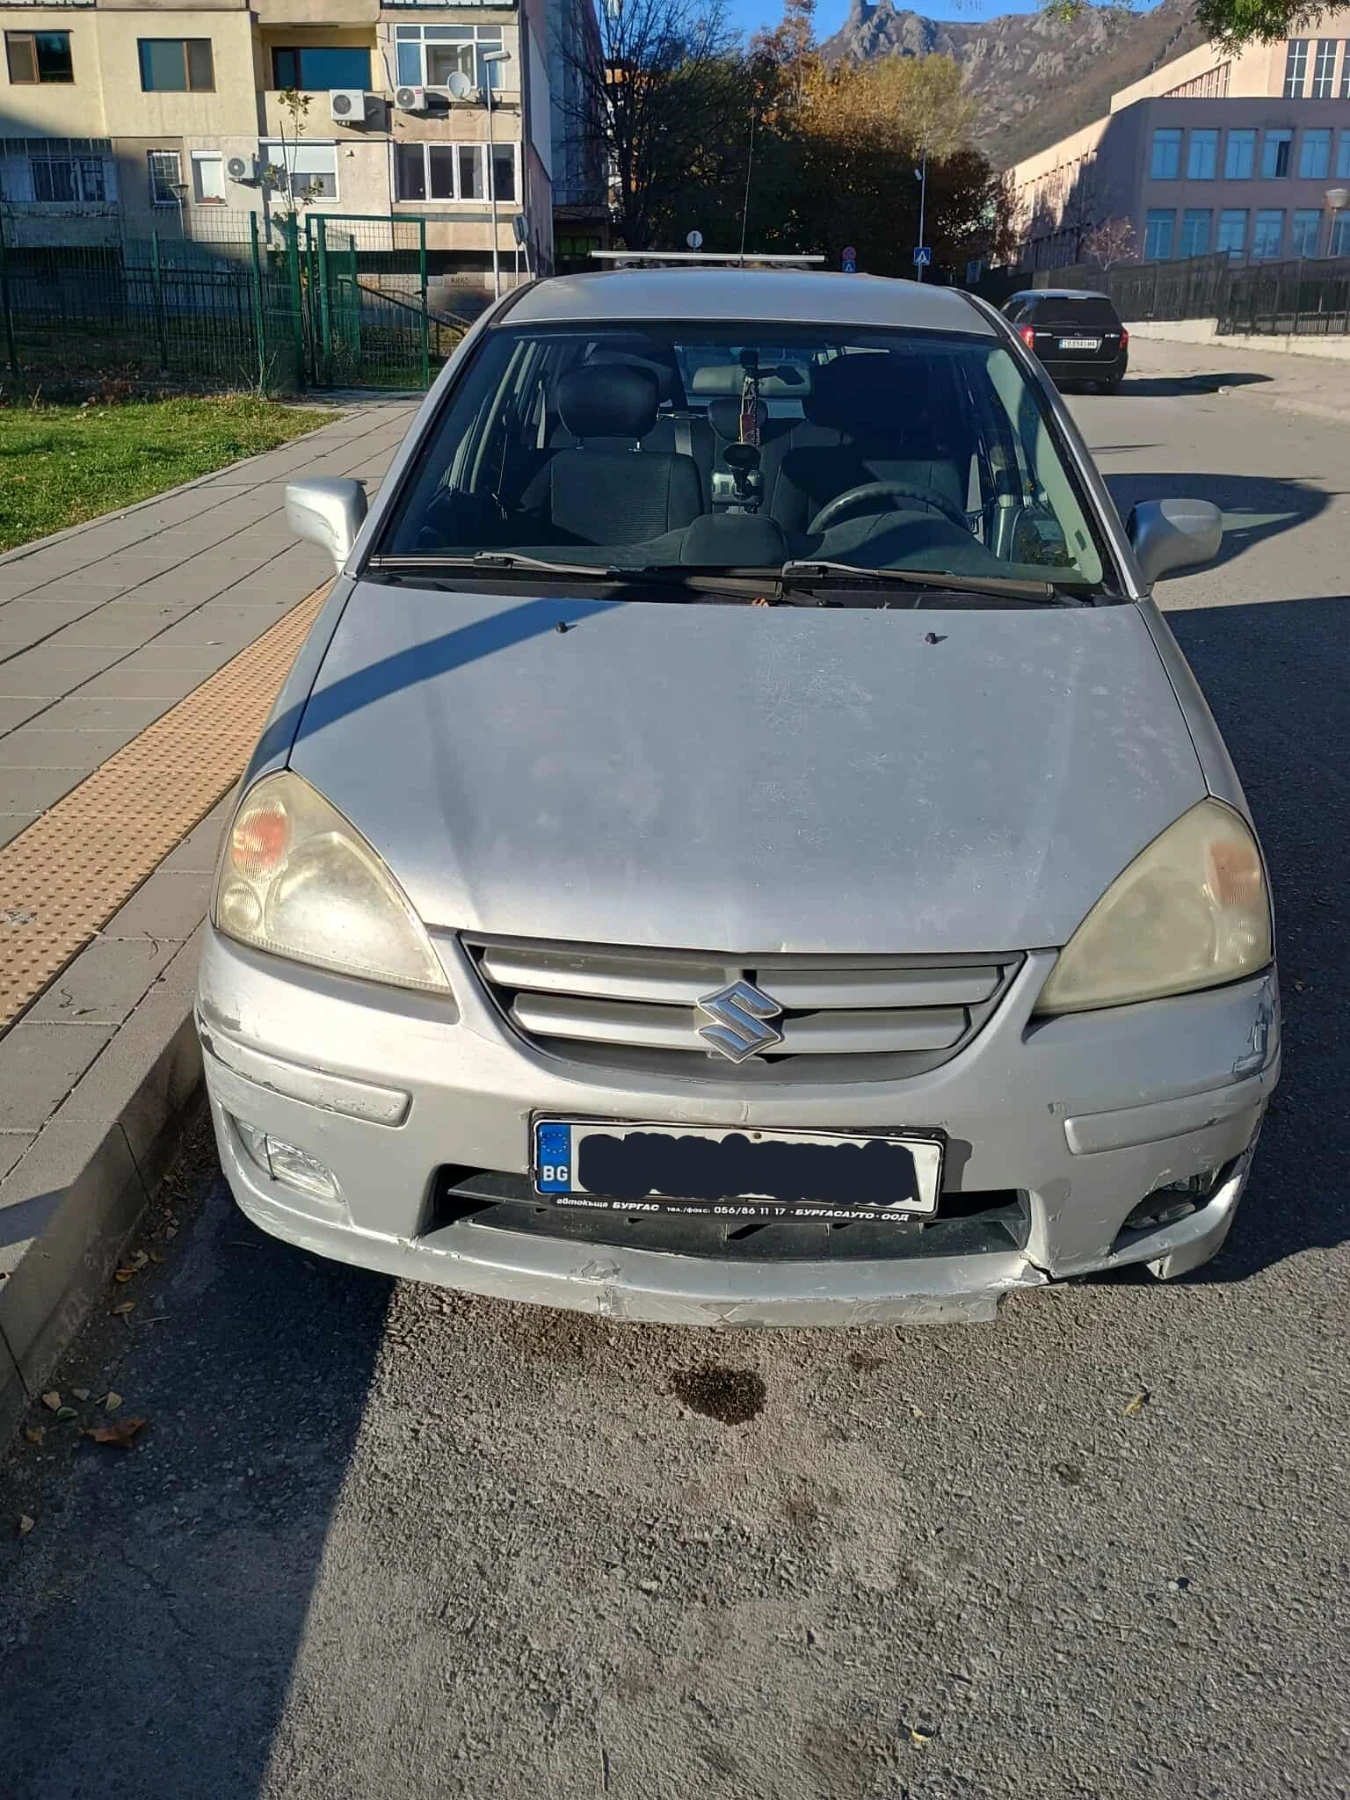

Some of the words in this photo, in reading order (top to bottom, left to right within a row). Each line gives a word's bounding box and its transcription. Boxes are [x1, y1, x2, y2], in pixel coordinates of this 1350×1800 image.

[543, 1165, 568, 1181] BG
[612, 1201, 660, 1211] БУРГАС
[714, 1206, 756, 1215] 056/86
[760, 1207, 769, 1215] 11
[775, 1208, 786, 1216] 17
